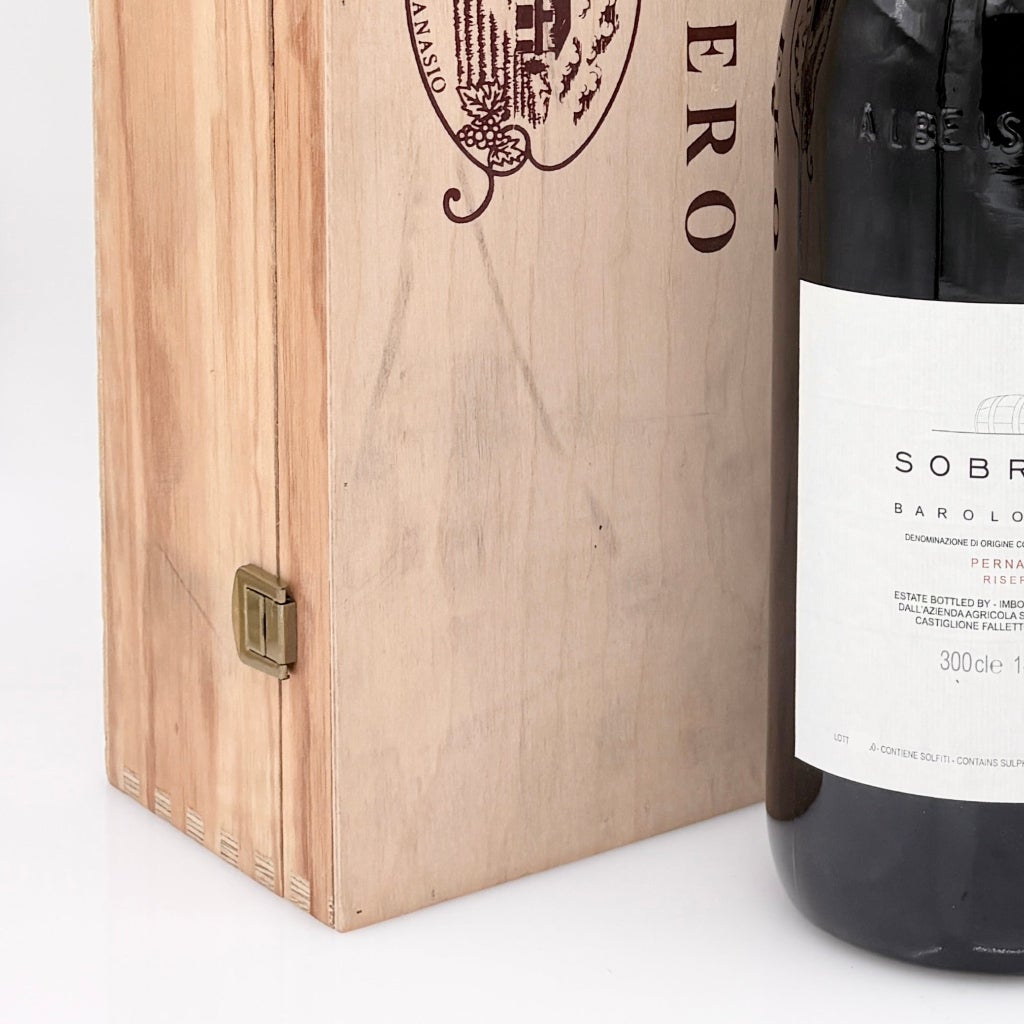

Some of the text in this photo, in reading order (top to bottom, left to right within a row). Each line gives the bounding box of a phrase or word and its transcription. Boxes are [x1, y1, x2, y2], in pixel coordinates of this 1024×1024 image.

[894, 502, 1024, 522] BAROLO
[905, 533, 969, 547] DENOMINAZIONE
[970, 539, 979, 547] DI
[980, 539, 1014, 549] ORIGINE
[894, 590, 928, 604] ESTATE
[930, 594, 976, 608] BOTTLED
[977, 599, 991, 608] BY
[898, 602, 964, 617] DALL'AZIENDA
[964, 609, 1017, 620] AGRICOLA
[915, 616, 980, 631] CASTIGLIONE
[880, 745, 919, 760] CONTIENE
[920, 752, 951, 764] SOLFITI
[956, 756, 999, 767] CONTAINS
